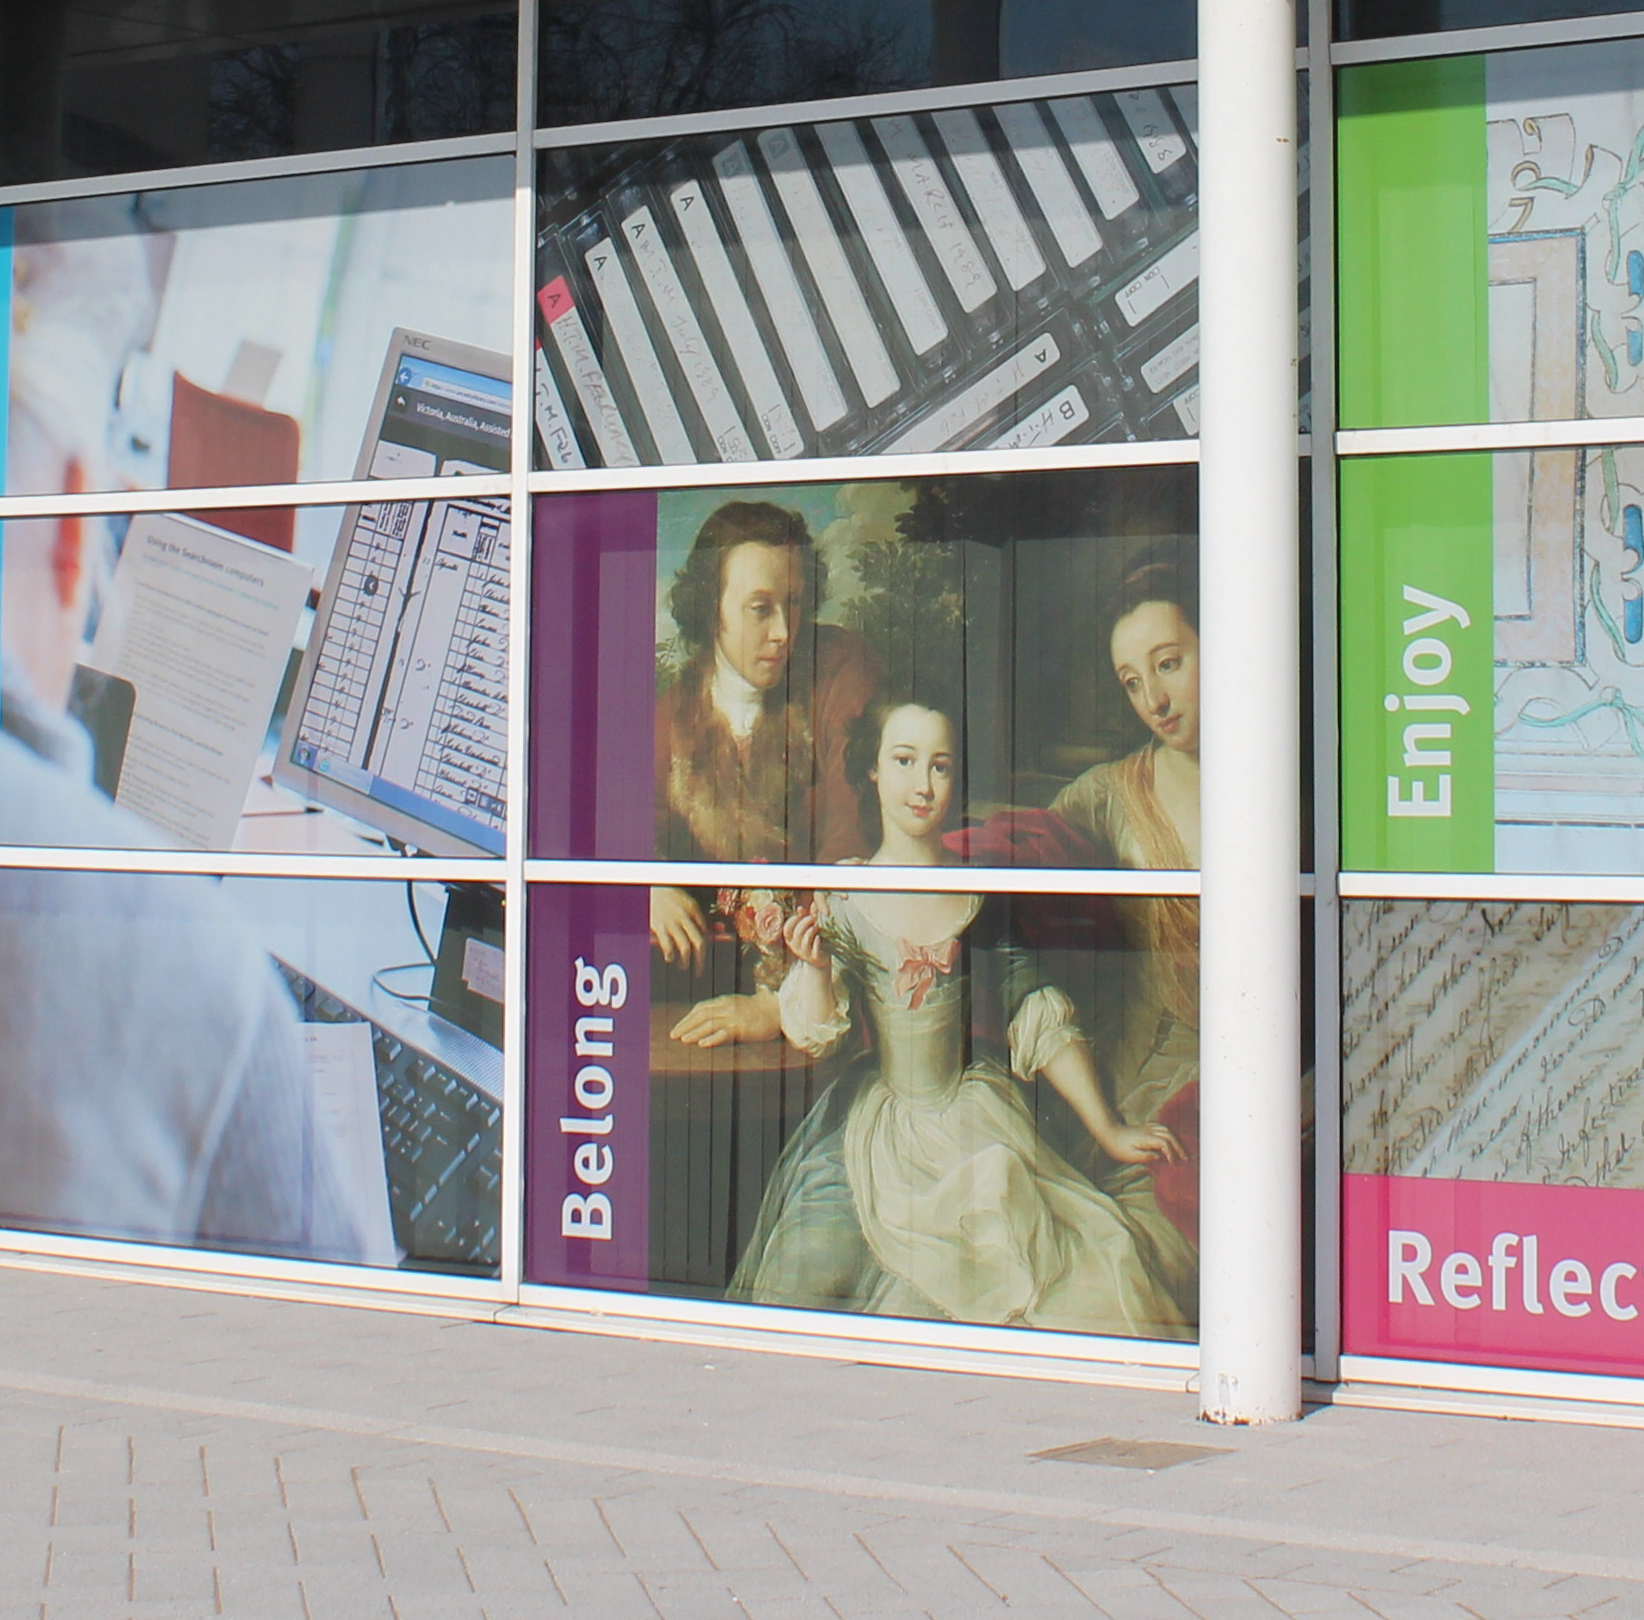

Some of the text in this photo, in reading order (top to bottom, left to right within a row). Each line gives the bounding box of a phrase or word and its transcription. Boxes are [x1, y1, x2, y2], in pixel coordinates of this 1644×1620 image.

[680, 195, 695, 212] A
[631, 223, 646, 239] A
[593, 256, 608, 271] A
[547, 292, 563, 309] A
[403, 335, 432, 350] NEC
[1034, 348, 1047, 364] A
[416, 402, 445, 421] Victoria,
[445, 412, 479, 431] Australia,
[1058, 399, 1076, 421] B
[147, 535, 168, 551] Using
[168, 542, 181, 555] the
[225, 565, 265, 587] computers
[1382, 583, 1472, 820] Enjoy
[559, 954, 630, 1241] Belong
